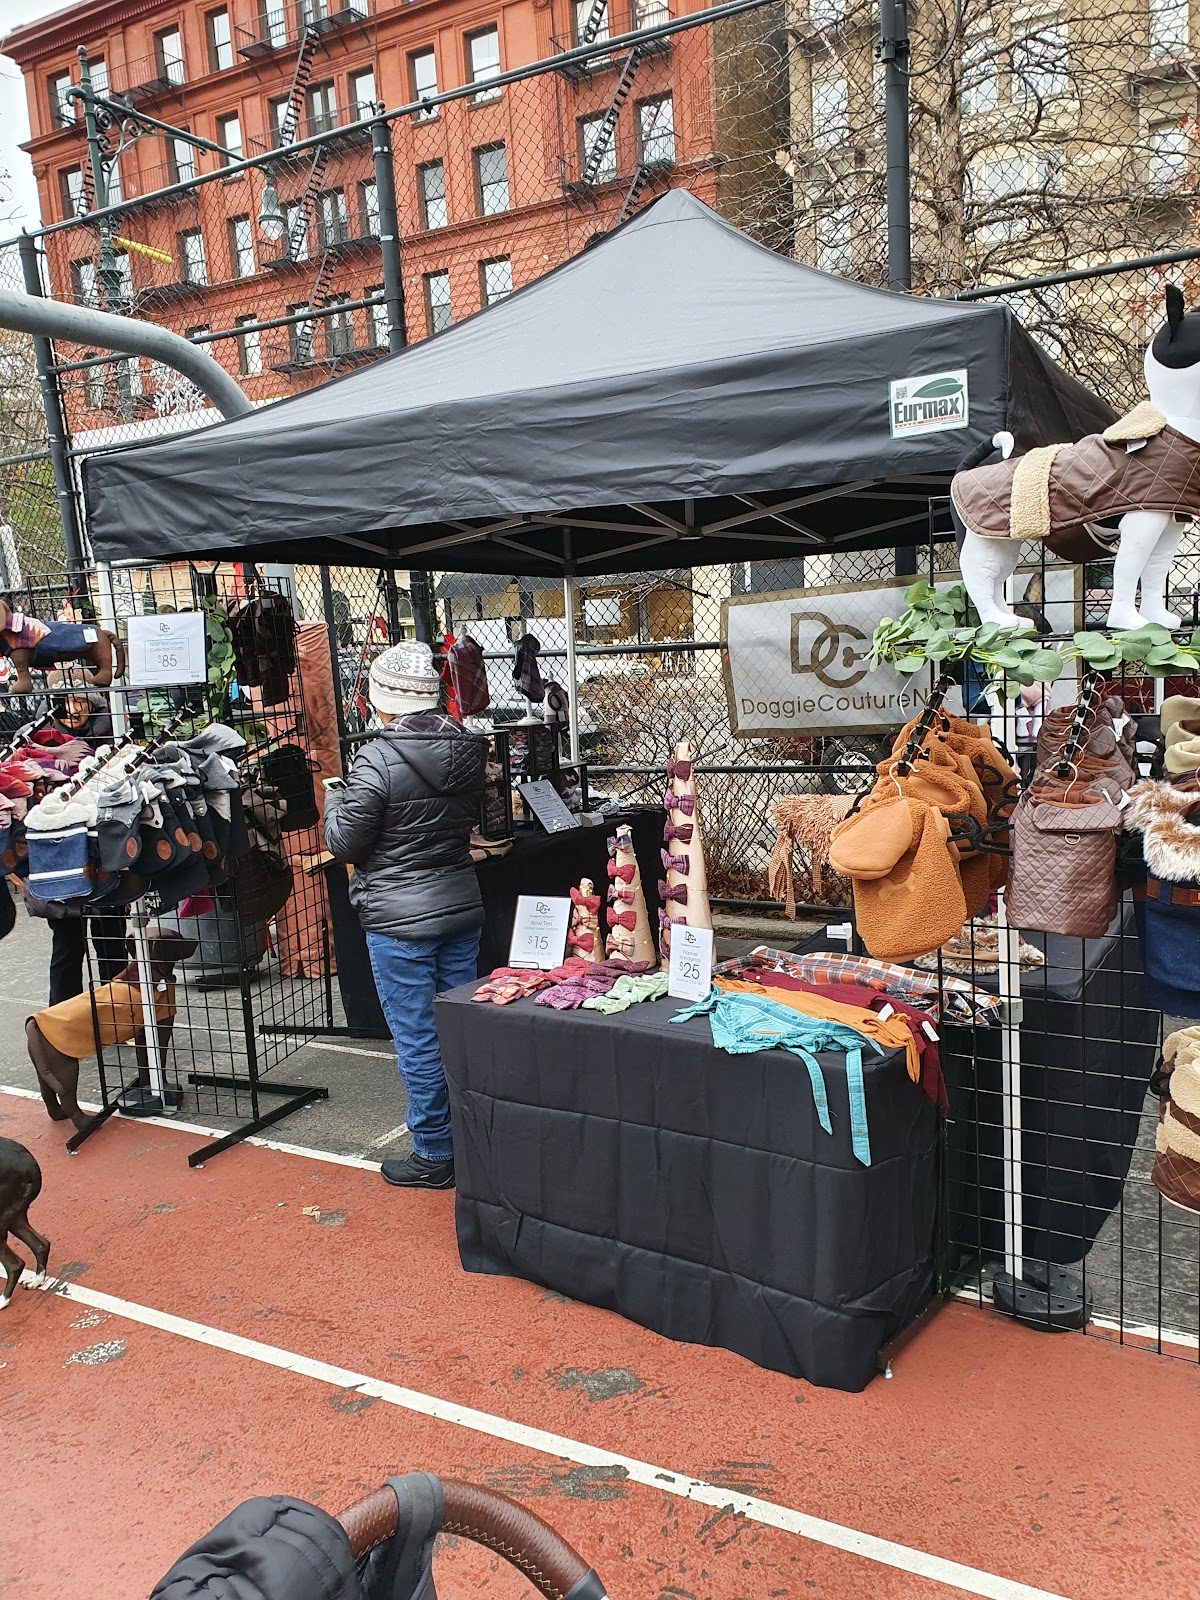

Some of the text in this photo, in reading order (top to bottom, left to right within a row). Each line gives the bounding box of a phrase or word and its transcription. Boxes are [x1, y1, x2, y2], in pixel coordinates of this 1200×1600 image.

[894, 397, 960, 424] Eurmax
[157, 653, 178, 668] $85
[527, 935, 549, 950] $15
[679, 961, 700, 980] $25
